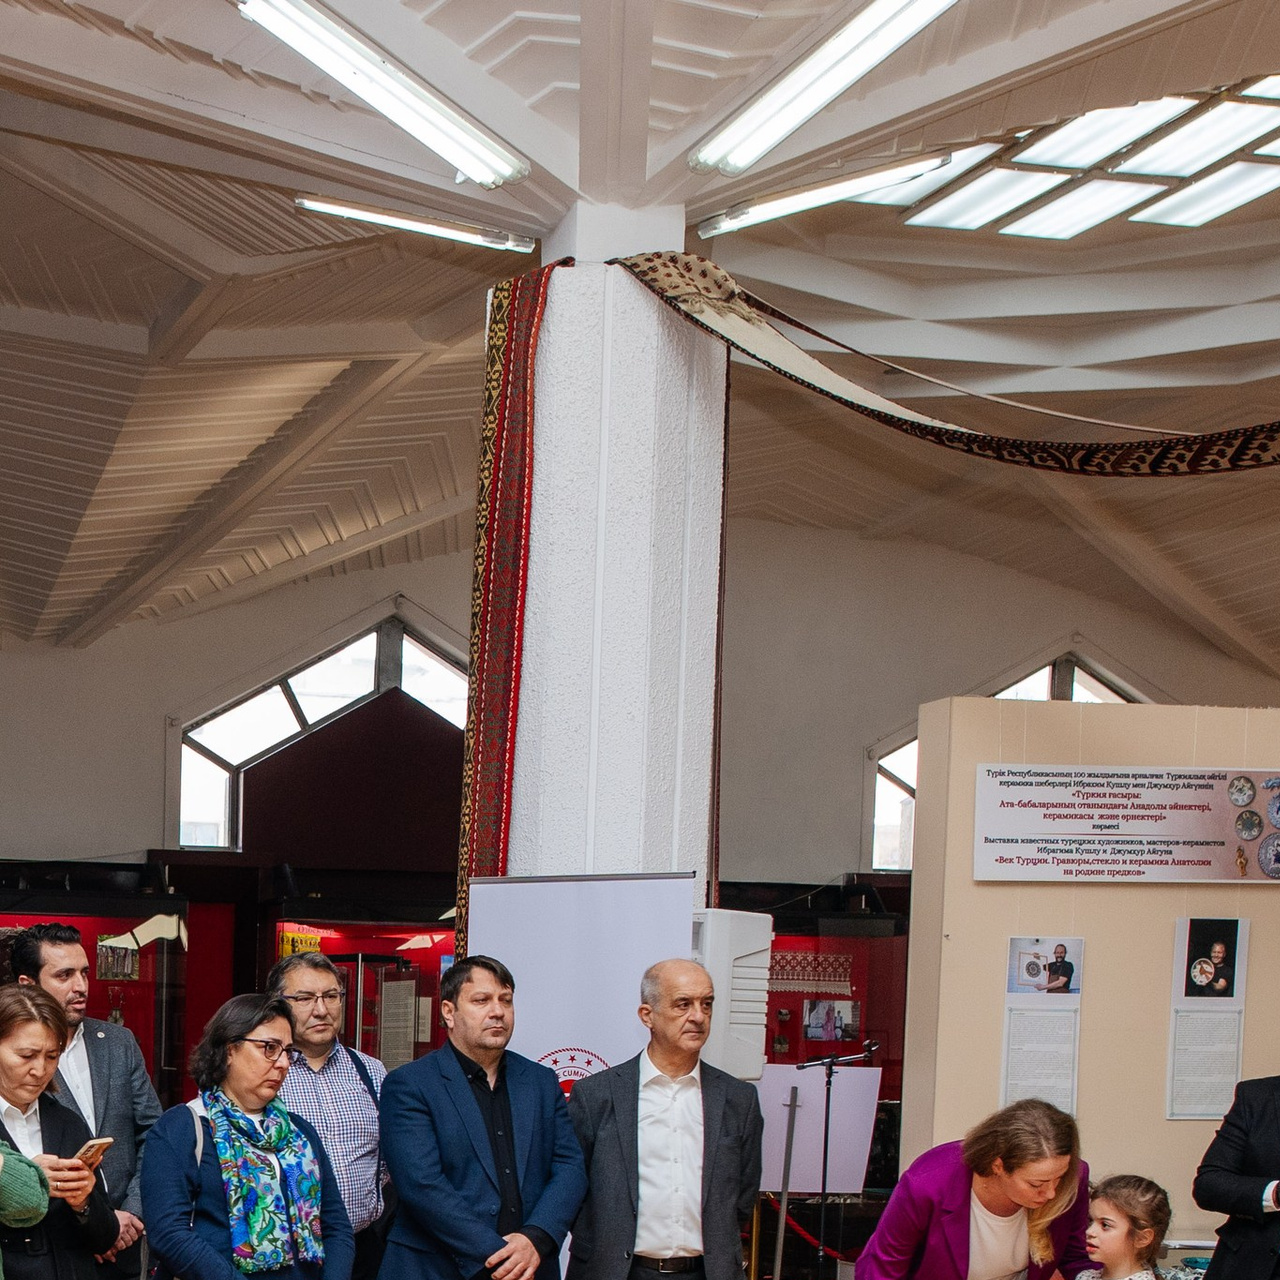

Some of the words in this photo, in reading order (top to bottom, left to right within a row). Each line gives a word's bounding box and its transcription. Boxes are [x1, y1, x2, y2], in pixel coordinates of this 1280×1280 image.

[999, 780, 1033, 788] керамика
[999, 800, 1076, 811] Ата-бабаларының
[1129, 802, 1167, 811] Анадолы
[1043, 812, 1094, 821] керамикасы
[984, 836, 1019, 844] Выставка
[1097, 839, 1145, 847] художников,
[1146, 840, 1226, 848] мастеров-керамистов
[1036, 846, 1074, 855] Ибрагима
[1075, 847, 1101, 856] Кушлу
[1146, 848, 1173, 856] Айгуна
[995, 856, 1014, 864] «Век
[1016, 856, 1050, 866] Турции.
[1128, 859, 1169, 868] керамика
[1170, 858, 1212, 867] Анатолии
[1075, 869, 1106, 878] родине
[1107, 869, 1146, 878] предков»
